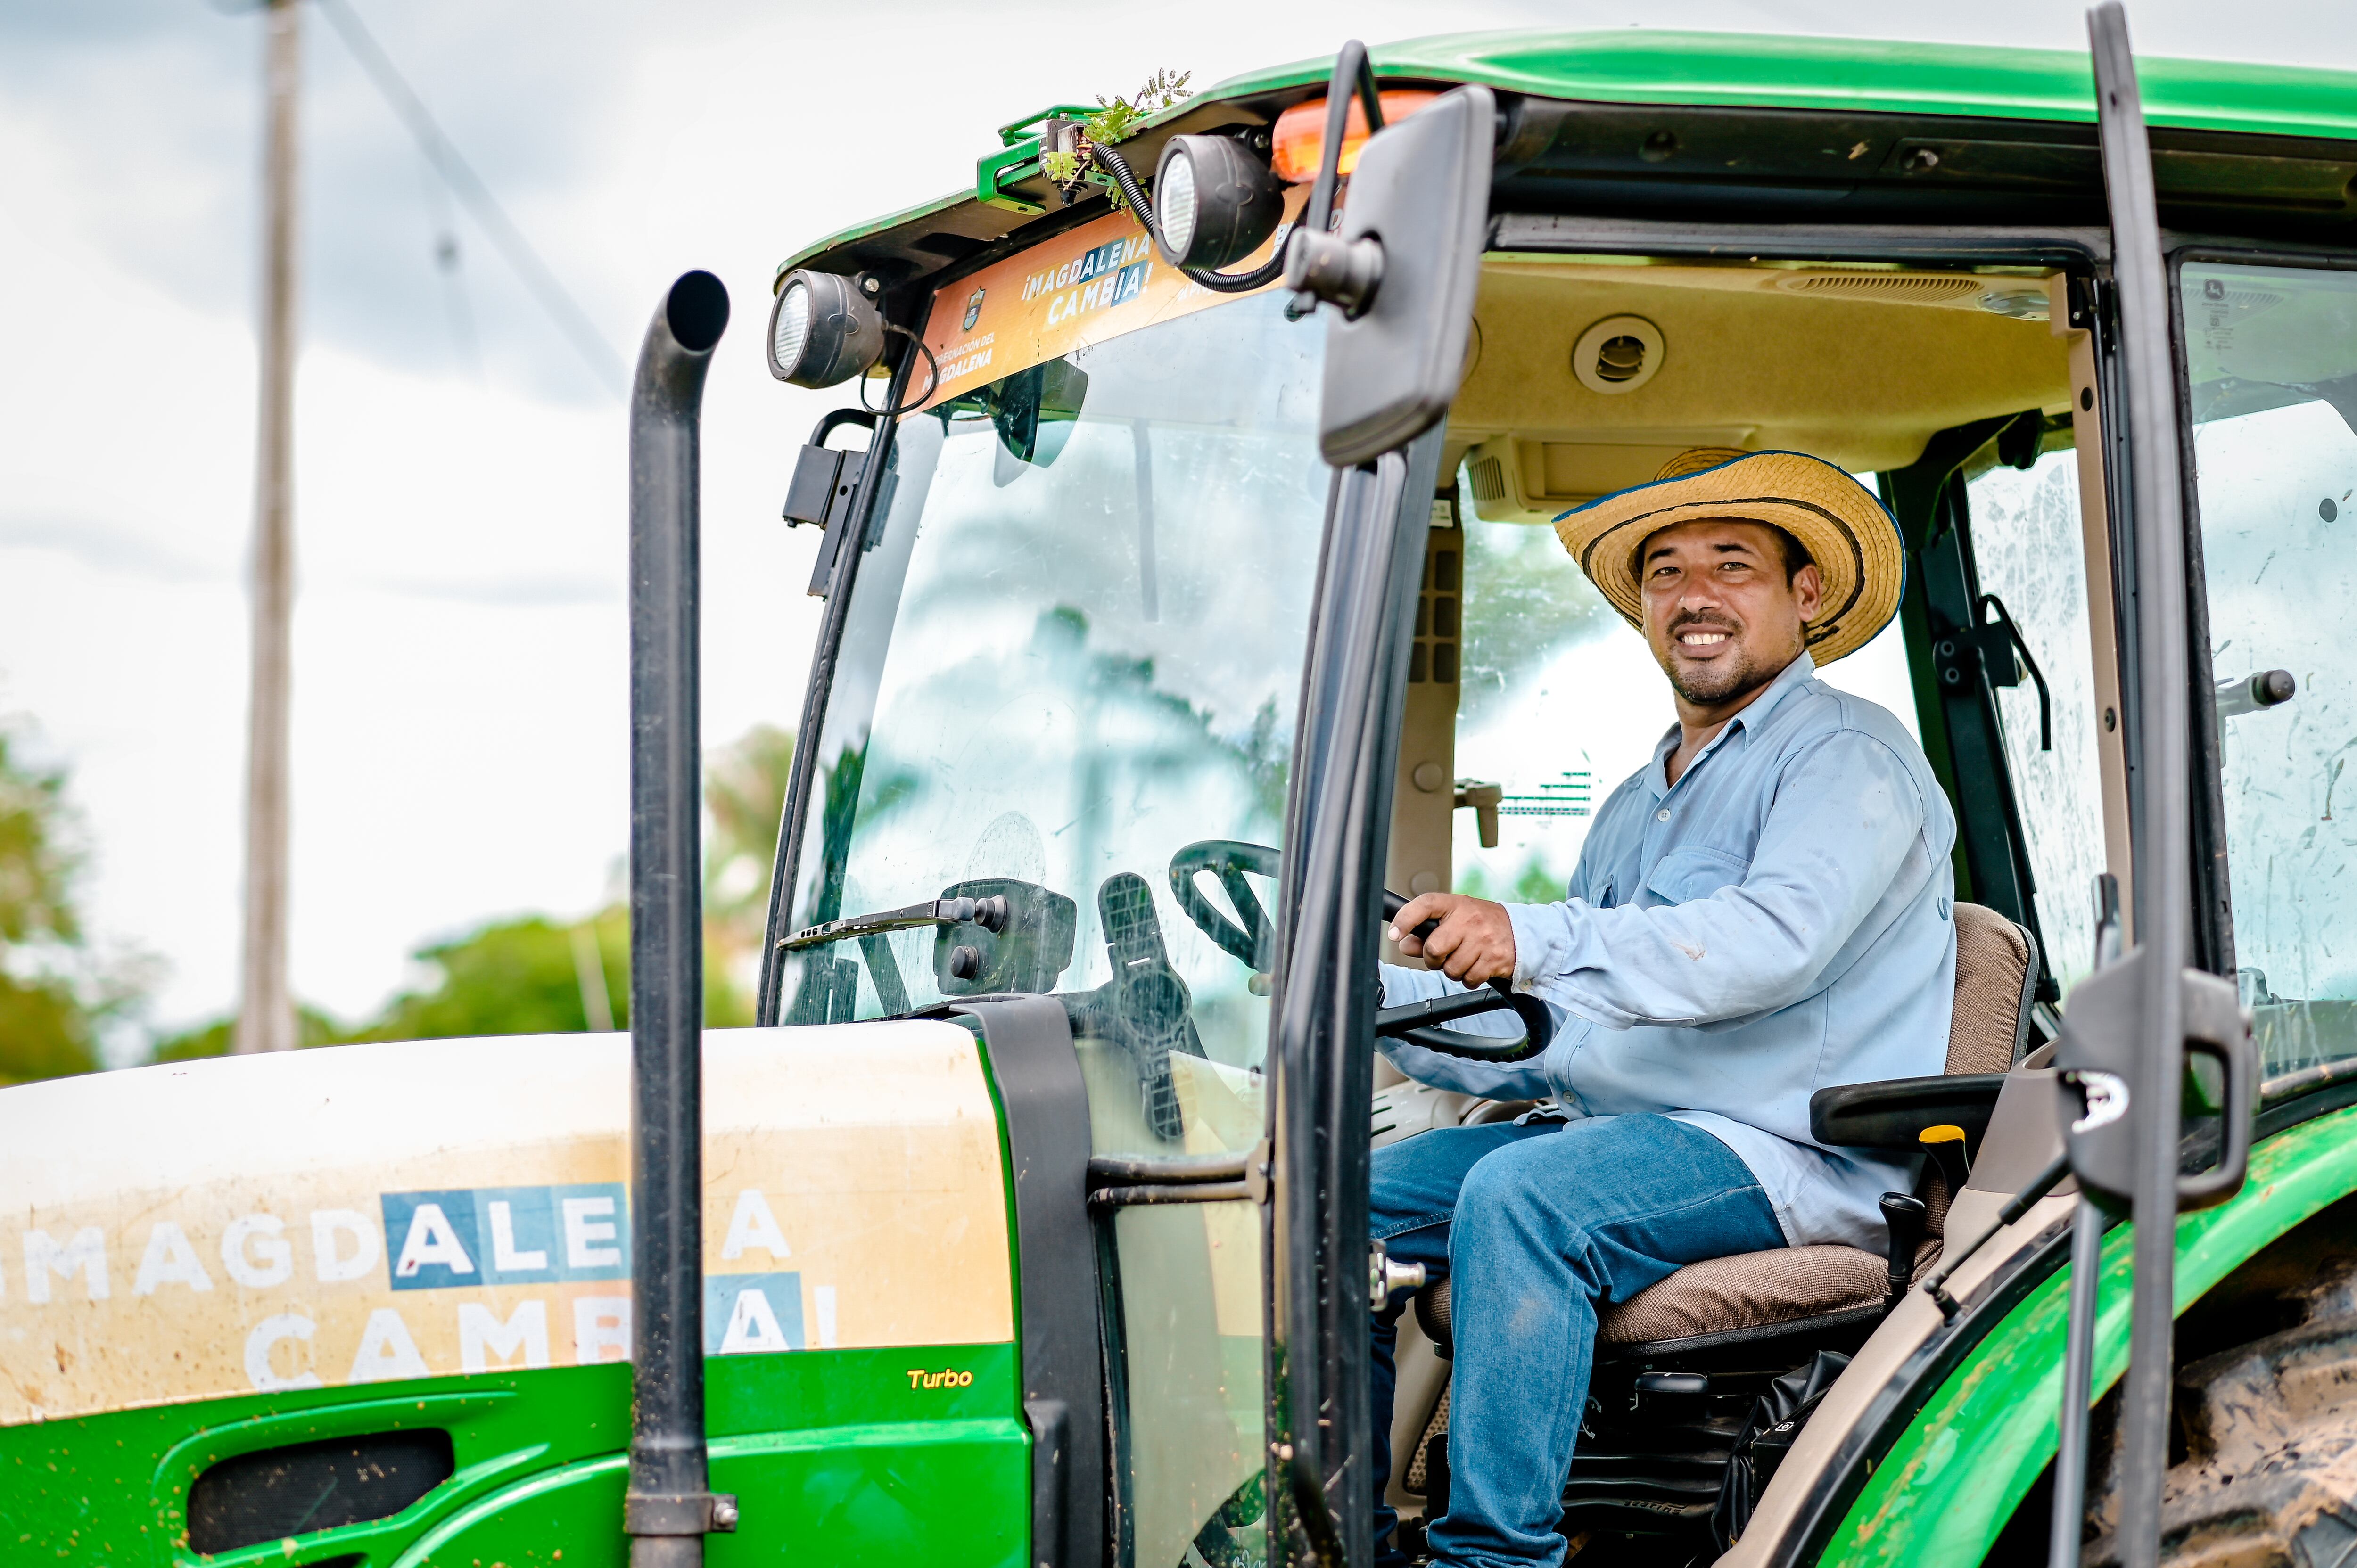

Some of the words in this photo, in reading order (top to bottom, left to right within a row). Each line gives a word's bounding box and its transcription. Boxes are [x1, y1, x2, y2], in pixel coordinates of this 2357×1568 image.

[1021, 232, 1150, 301] ¡MAGDALENA
[1048, 262, 1154, 325] CAMBIA!
[922, 348, 992, 393] MGDALENA
[981, 332, 995, 346] DEL
[0, 1189, 791, 1304] MAGDALEA
[244, 1285, 836, 1393] CAMBA!
[907, 1368, 973, 1389] Turbo
